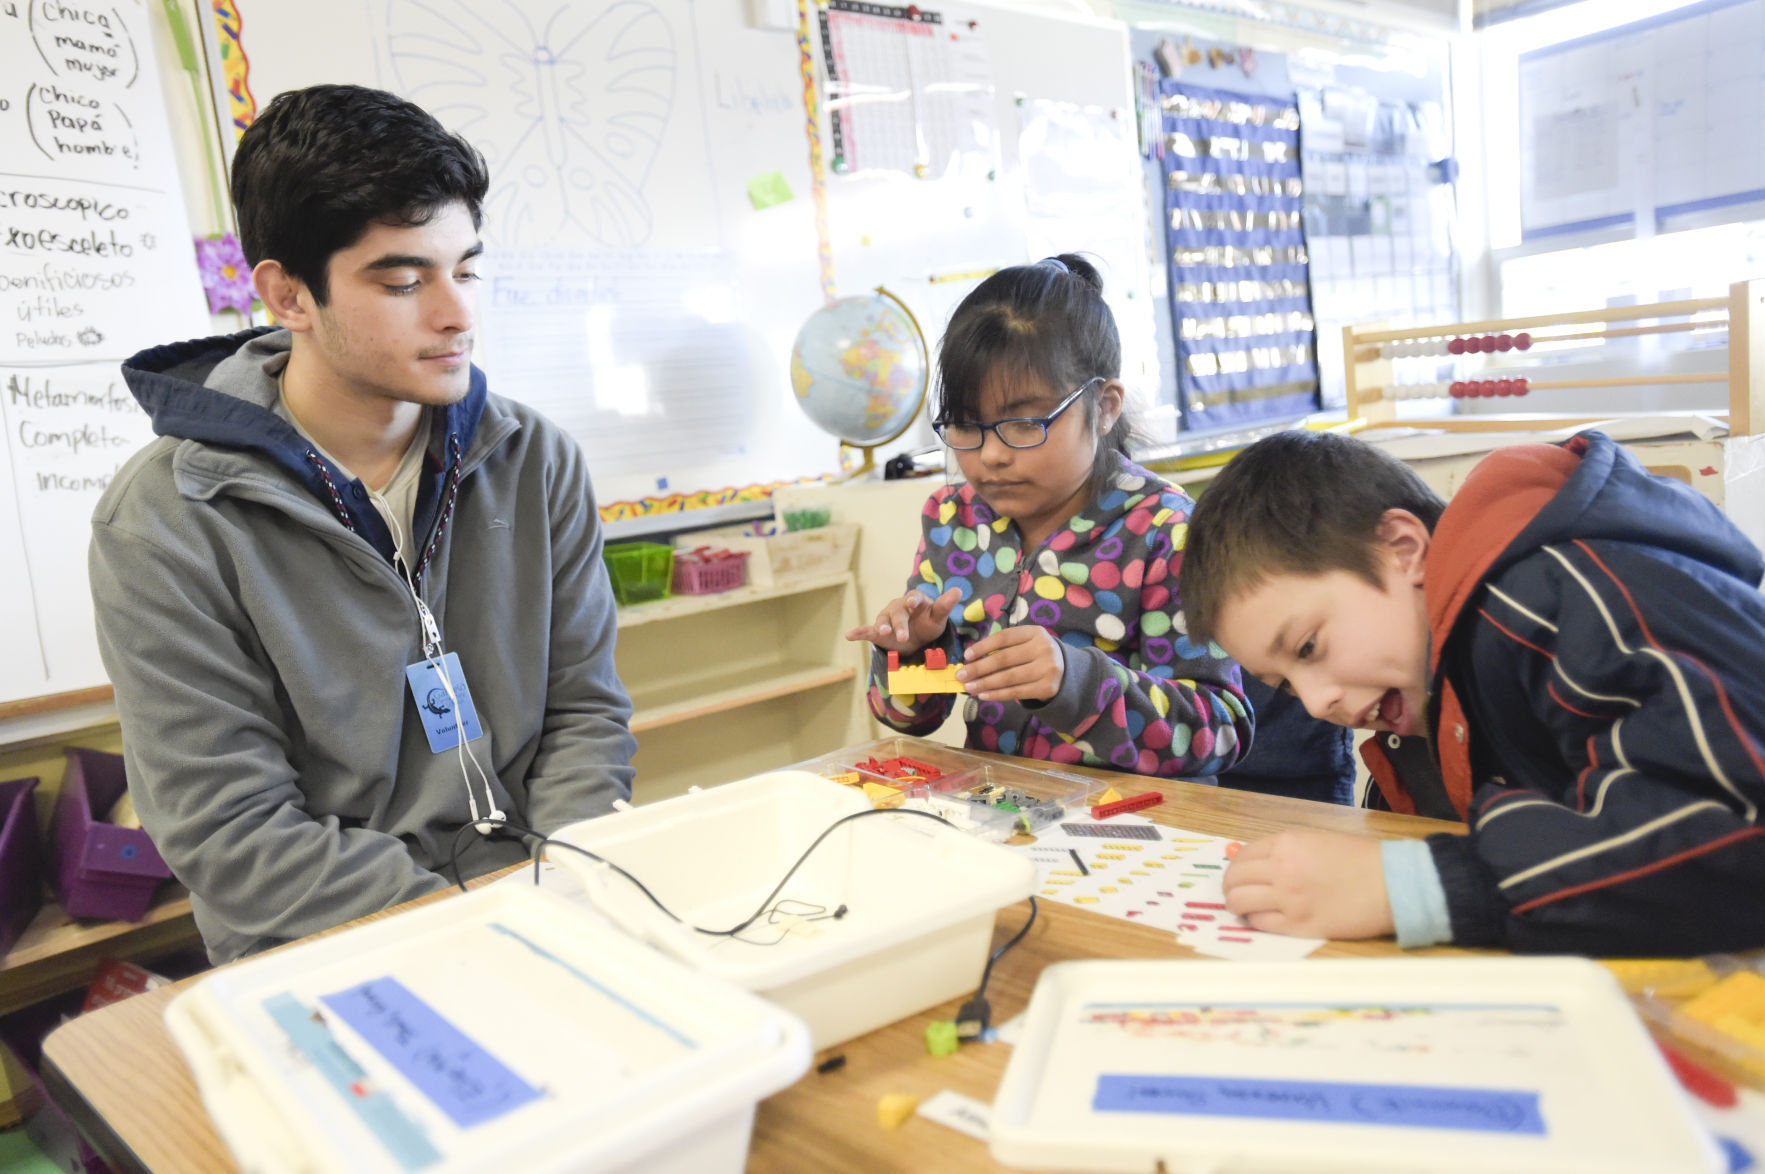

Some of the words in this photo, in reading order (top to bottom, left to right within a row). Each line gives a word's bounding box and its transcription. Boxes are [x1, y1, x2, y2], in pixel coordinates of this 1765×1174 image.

[39, 84, 101, 110] Chico
[53, 136, 132, 159] hombe
[0, 226, 134, 259] xoesceleto
[19, 420, 130, 454] Completa
